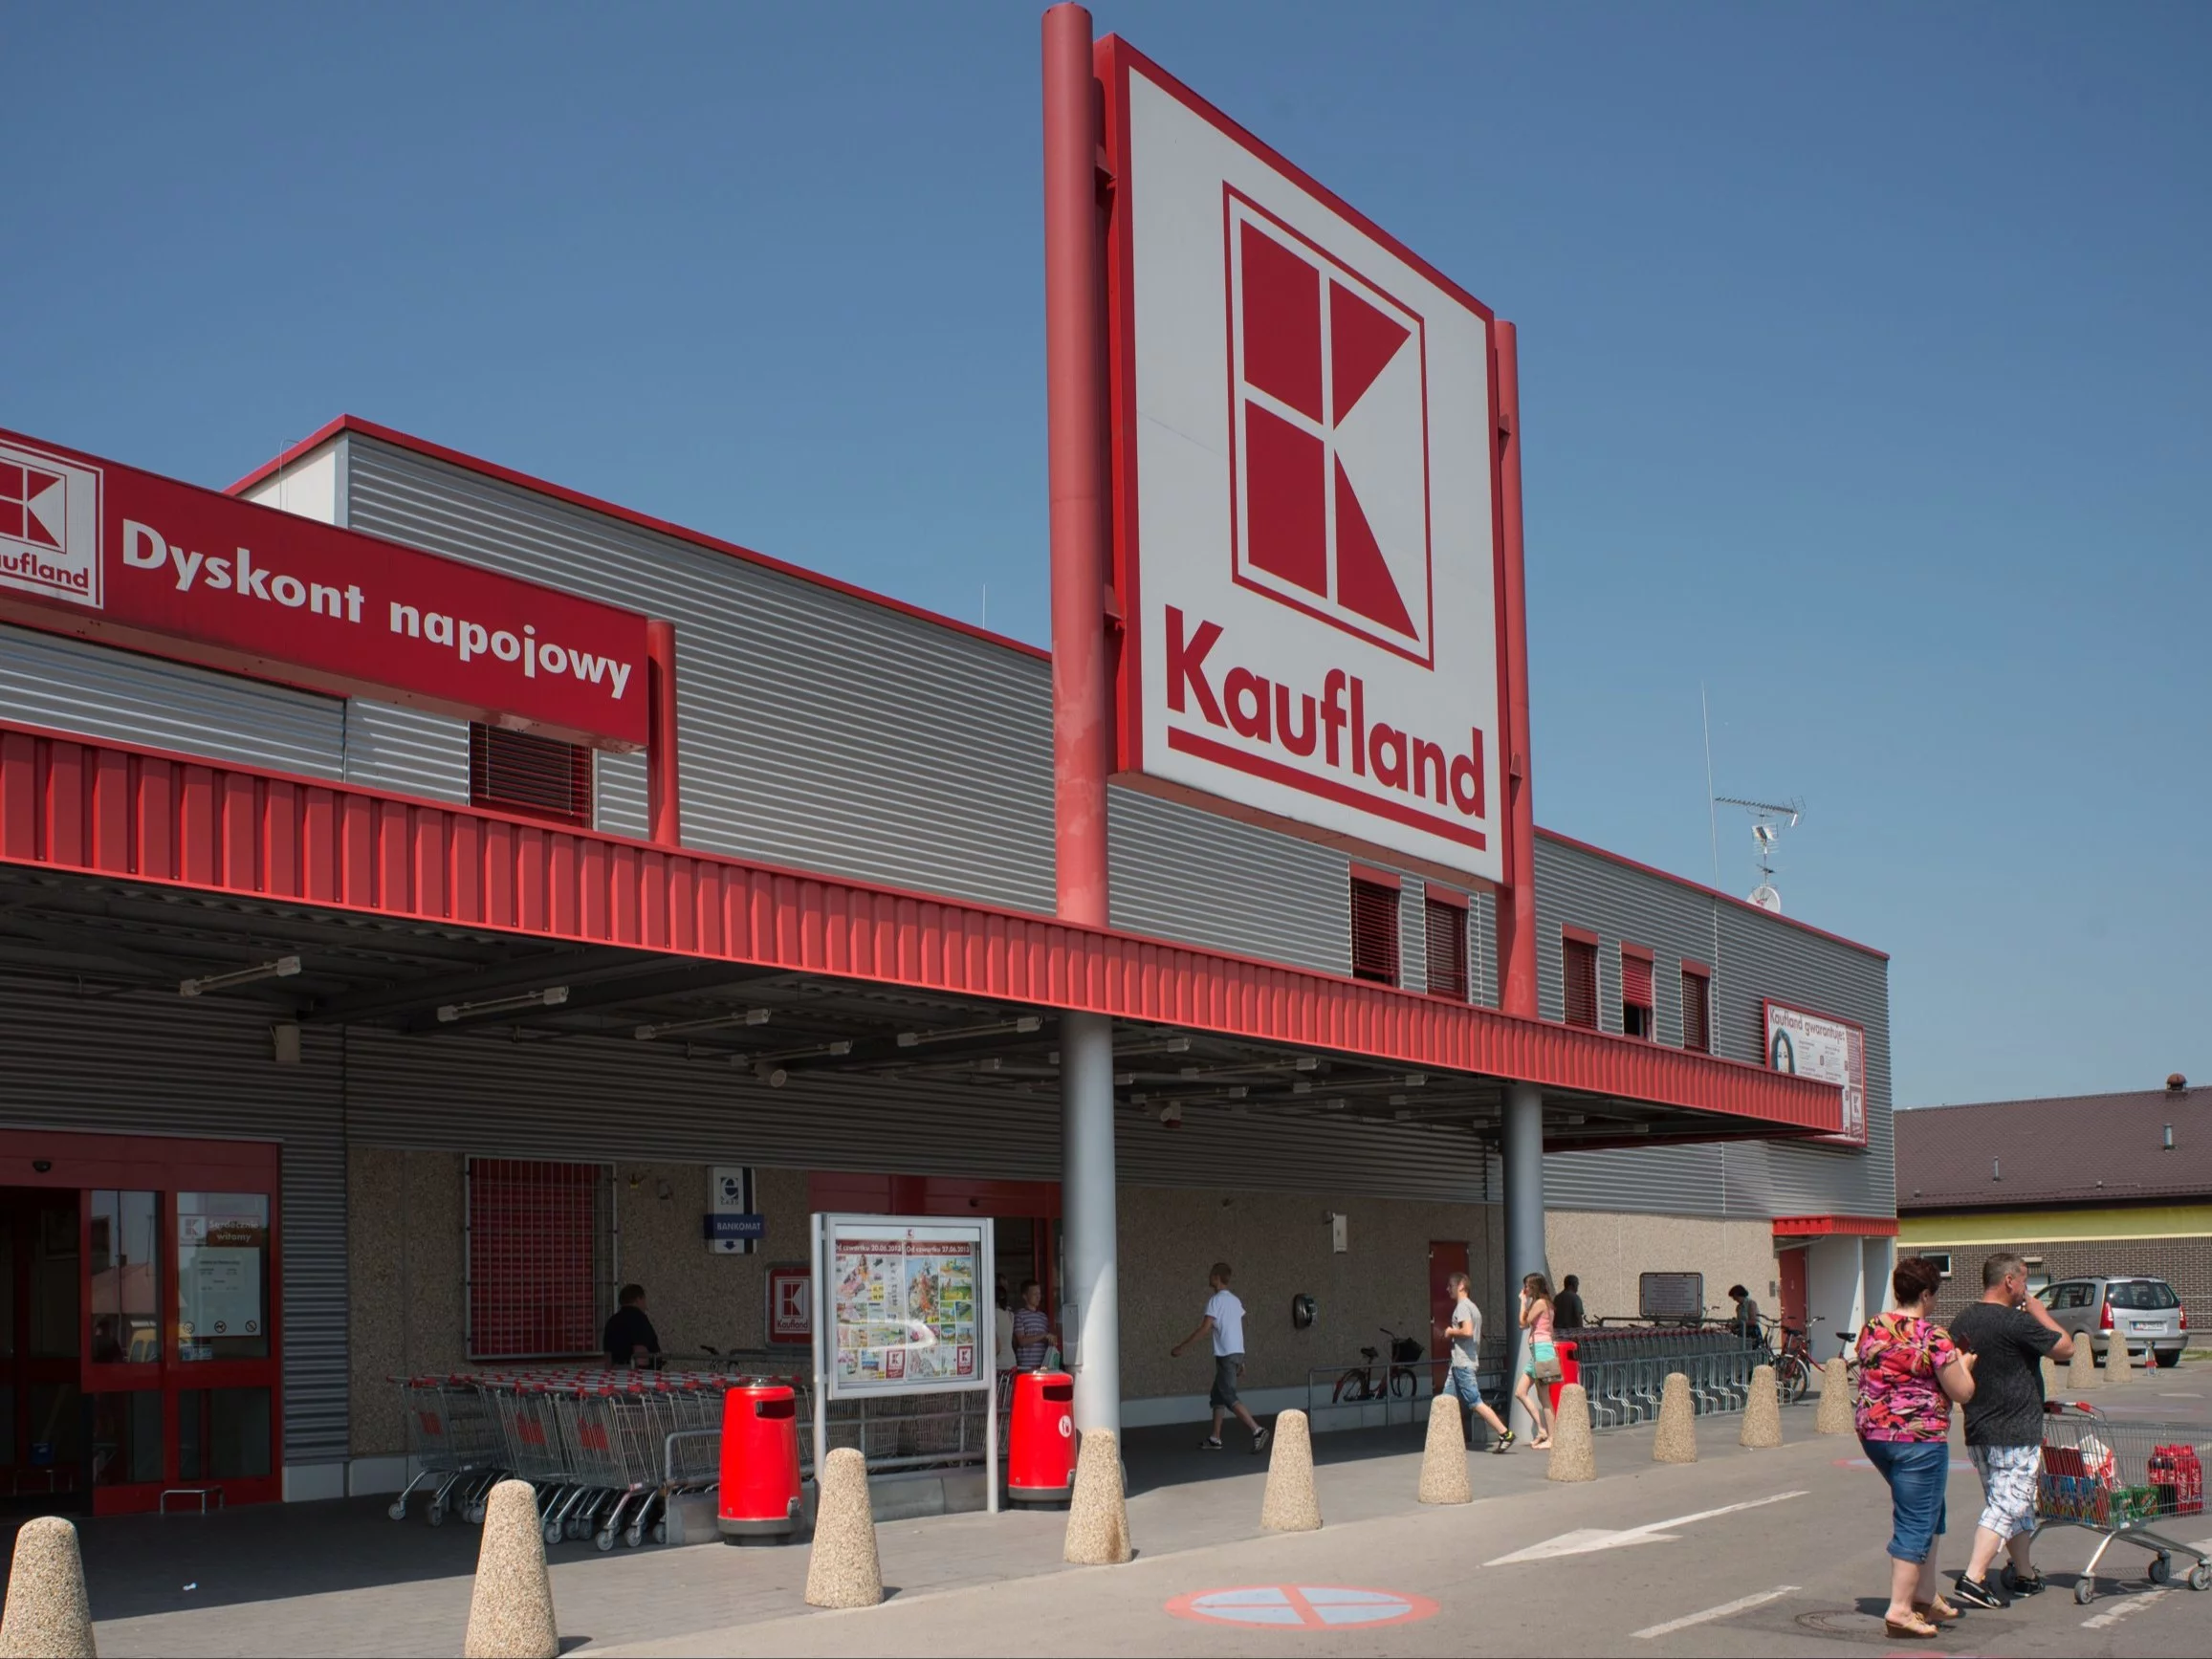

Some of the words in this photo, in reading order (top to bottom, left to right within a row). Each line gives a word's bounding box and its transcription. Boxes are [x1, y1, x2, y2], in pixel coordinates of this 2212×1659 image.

[0, 552, 89, 589] ufland
[122, 518, 364, 623] Dyskont
[390, 601, 632, 699] napojowy
[1165, 603, 1486, 819] Kaufland
[1769, 1009, 1803, 1031] Kaufland
[216, 1232, 252, 1243] witamy
[716, 1221, 761, 1232] BANKOMAT
[777, 1319, 809, 1329] Kaufland
